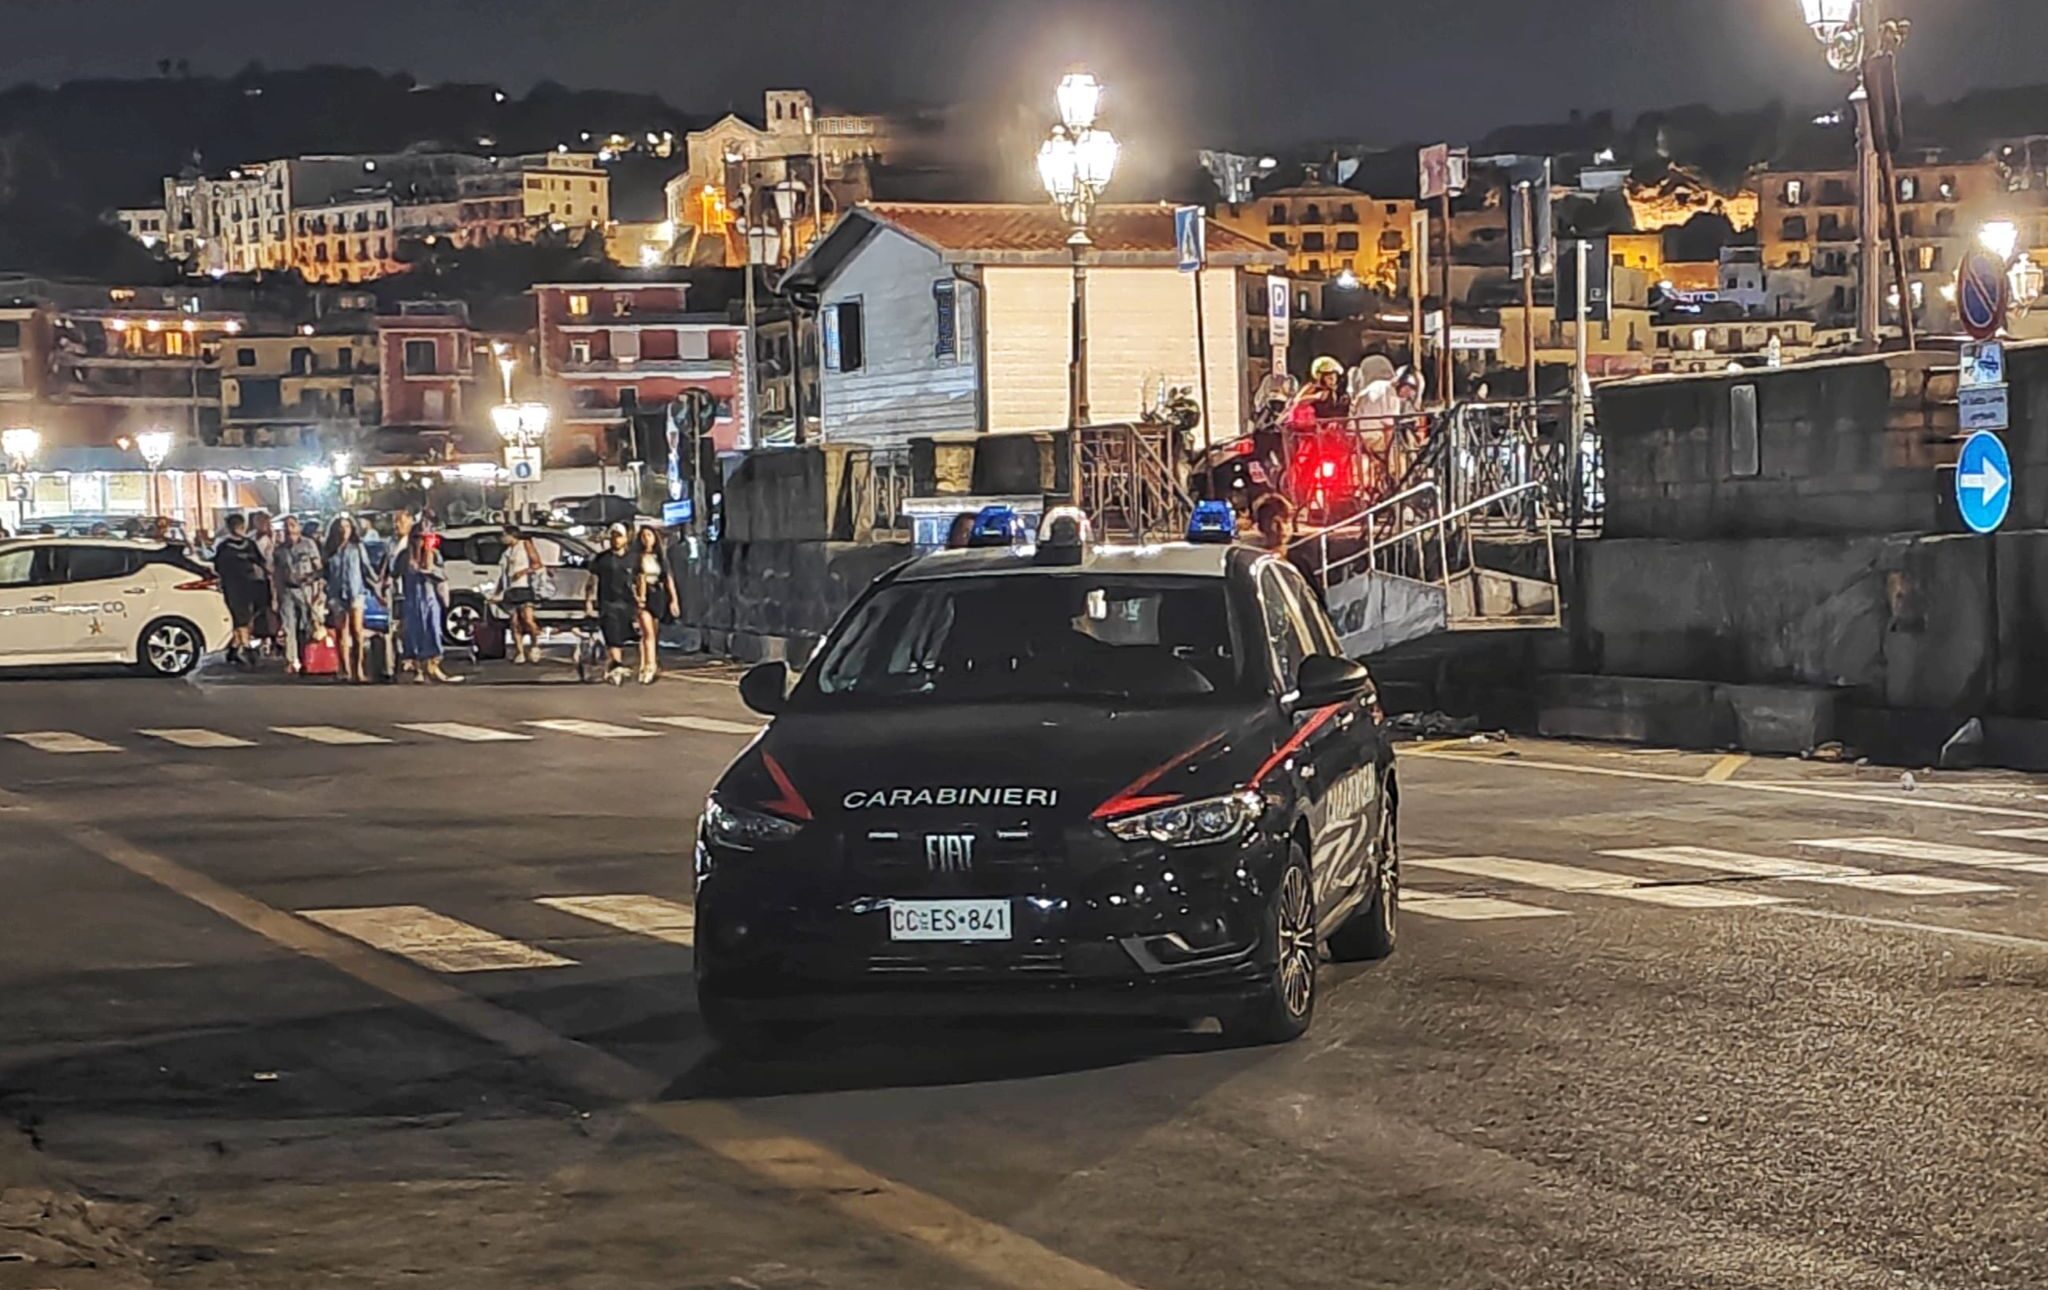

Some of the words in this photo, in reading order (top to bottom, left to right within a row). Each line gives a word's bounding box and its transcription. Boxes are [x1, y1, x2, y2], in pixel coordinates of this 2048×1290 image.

[1274, 286, 1284, 315] P
[843, 788, 1057, 808] CARABINIERI
[926, 835, 975, 872] FIAT
